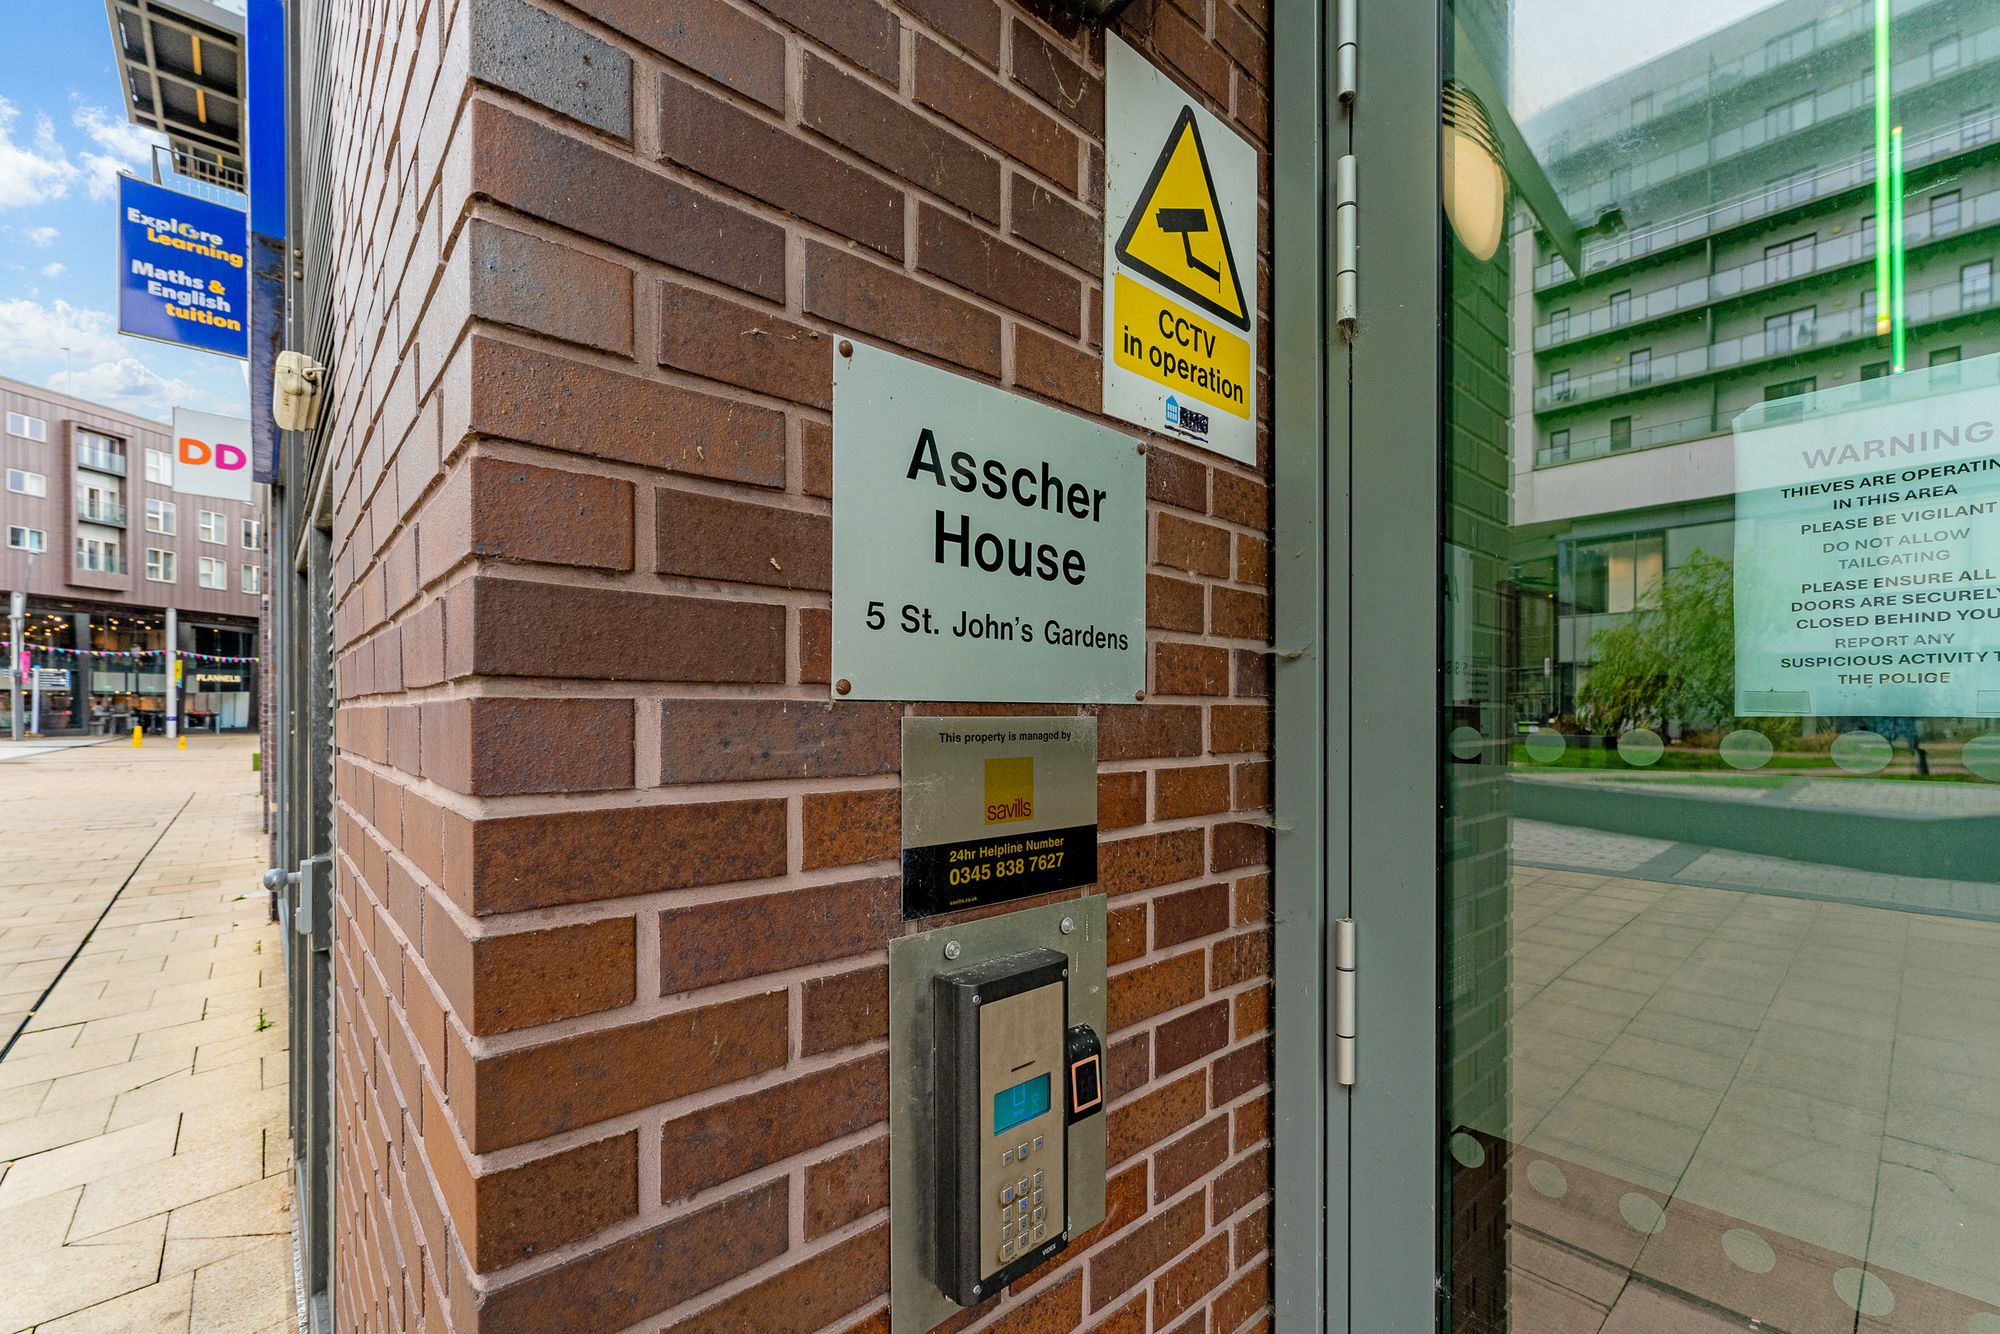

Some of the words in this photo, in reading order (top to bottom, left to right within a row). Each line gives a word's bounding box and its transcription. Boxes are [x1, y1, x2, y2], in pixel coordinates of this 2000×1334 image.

[127, 206, 224, 246] Explore
[147, 227, 244, 269] Learning
[131, 258, 205, 290] Maths
[208, 280, 226, 296] &
[147, 280, 231, 313] English
[165, 303, 241, 332] tuition
[1158, 309, 1216, 359] CCTV
[1123, 325, 1143, 360] in
[1149, 345, 1244, 404] operation
[1802, 421, 1994, 470] WARNING
[906, 428, 1107, 523] Asscher
[1781, 479, 1855, 499] THIEVES
[1859, 473, 1897, 489] ARE
[1833, 498, 1852, 510] IN
[1857, 492, 1900, 508] THIS
[1904, 484, 1958, 501] AREA
[1801, 517, 1868, 535] PLEASE
[1873, 513, 1897, 527] BE
[1901, 502, 1997, 524] VIGILANT
[935, 509, 1087, 586] House
[1823, 541, 1850, 554] DO
[1856, 536, 1894, 551] NOT
[1898, 528, 1971, 547] ALLOW
[1839, 549, 1951, 570] TAILGATING
[1802, 578, 1868, 594] PLEASE
[1873, 572, 1953, 589] ENSURE
[1958, 568, 1997, 582] ALL
[1791, 599, 1856, 612] DOORS
[1860, 595, 1897, 608] ARE
[866, 601, 885, 630] 5
[901, 604, 939, 636] St.
[952, 610, 1034, 643] John's
[1044, 619, 1129, 651] Gardens
[1796, 616, 1869, 630] CLOSED
[1874, 611, 1951, 626] BEHIND
[1957, 607, 2000, 621] YOU
[1835, 635, 1909, 649] REPORT
[1913, 633, 1956, 646] ANY
[1781, 655, 1894, 668] SUSPICIOUS
[1898, 651, 1988, 665] ACTIVITY
[1838, 674, 1873, 685] THE
[939, 732, 962, 743] This
[964, 732, 1006, 744] property
[1008, 731, 1017, 741] is
[1019, 731, 1059, 742] managed
[1061, 731, 1072, 742] by
[987, 797, 1032, 821] savills
[949, 849, 976, 863] 24hr
[979, 843, 1023, 859] Helpline
[1026, 836, 1065, 852] Number
[949, 864, 991, 886] 0345
[996, 858, 1025, 878] 838
[1029, 852, 1065, 872] 7627
